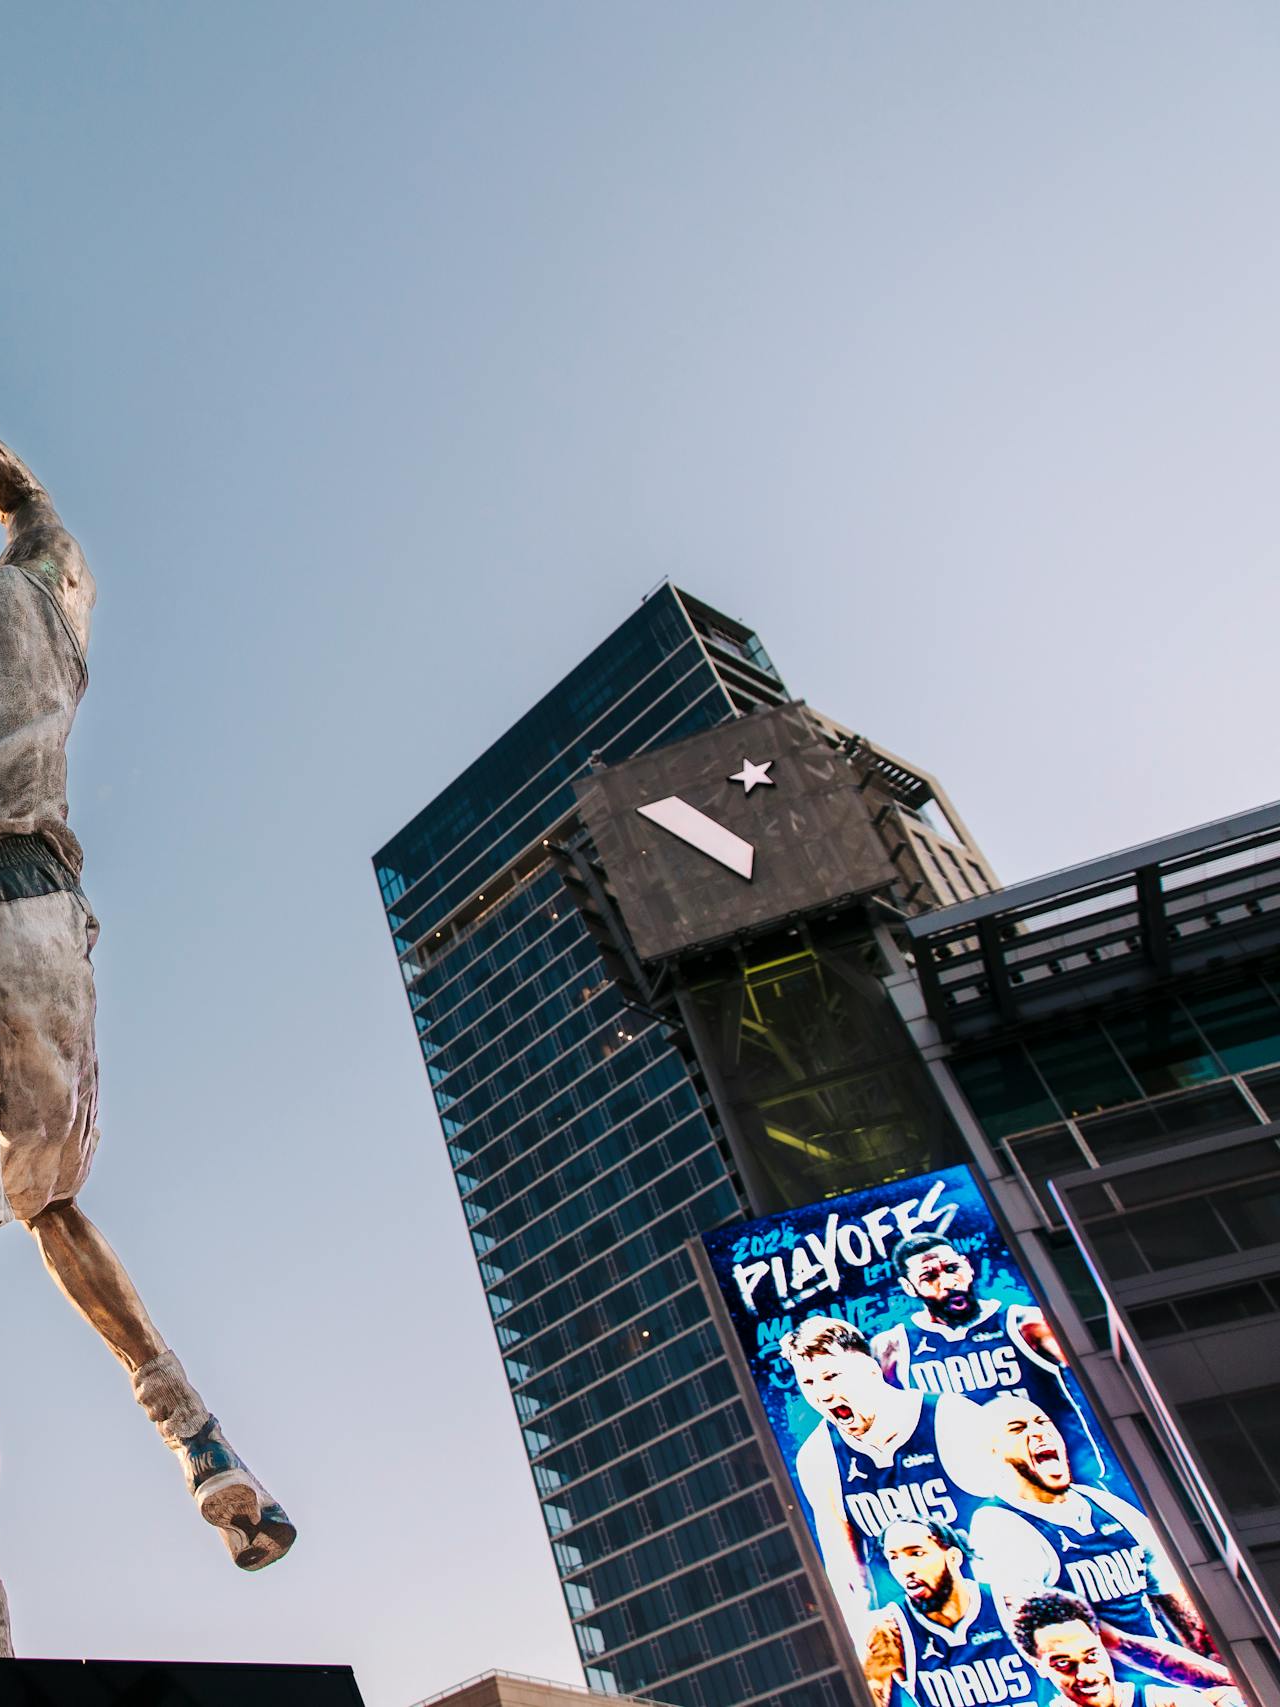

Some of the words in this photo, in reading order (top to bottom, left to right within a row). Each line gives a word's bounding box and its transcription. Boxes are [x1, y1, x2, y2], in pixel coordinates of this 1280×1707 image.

[731, 1221, 801, 1263] 2024
[732, 1180, 960, 1314] PLAYOFFS
[186, 1450, 217, 1476] NIKE
